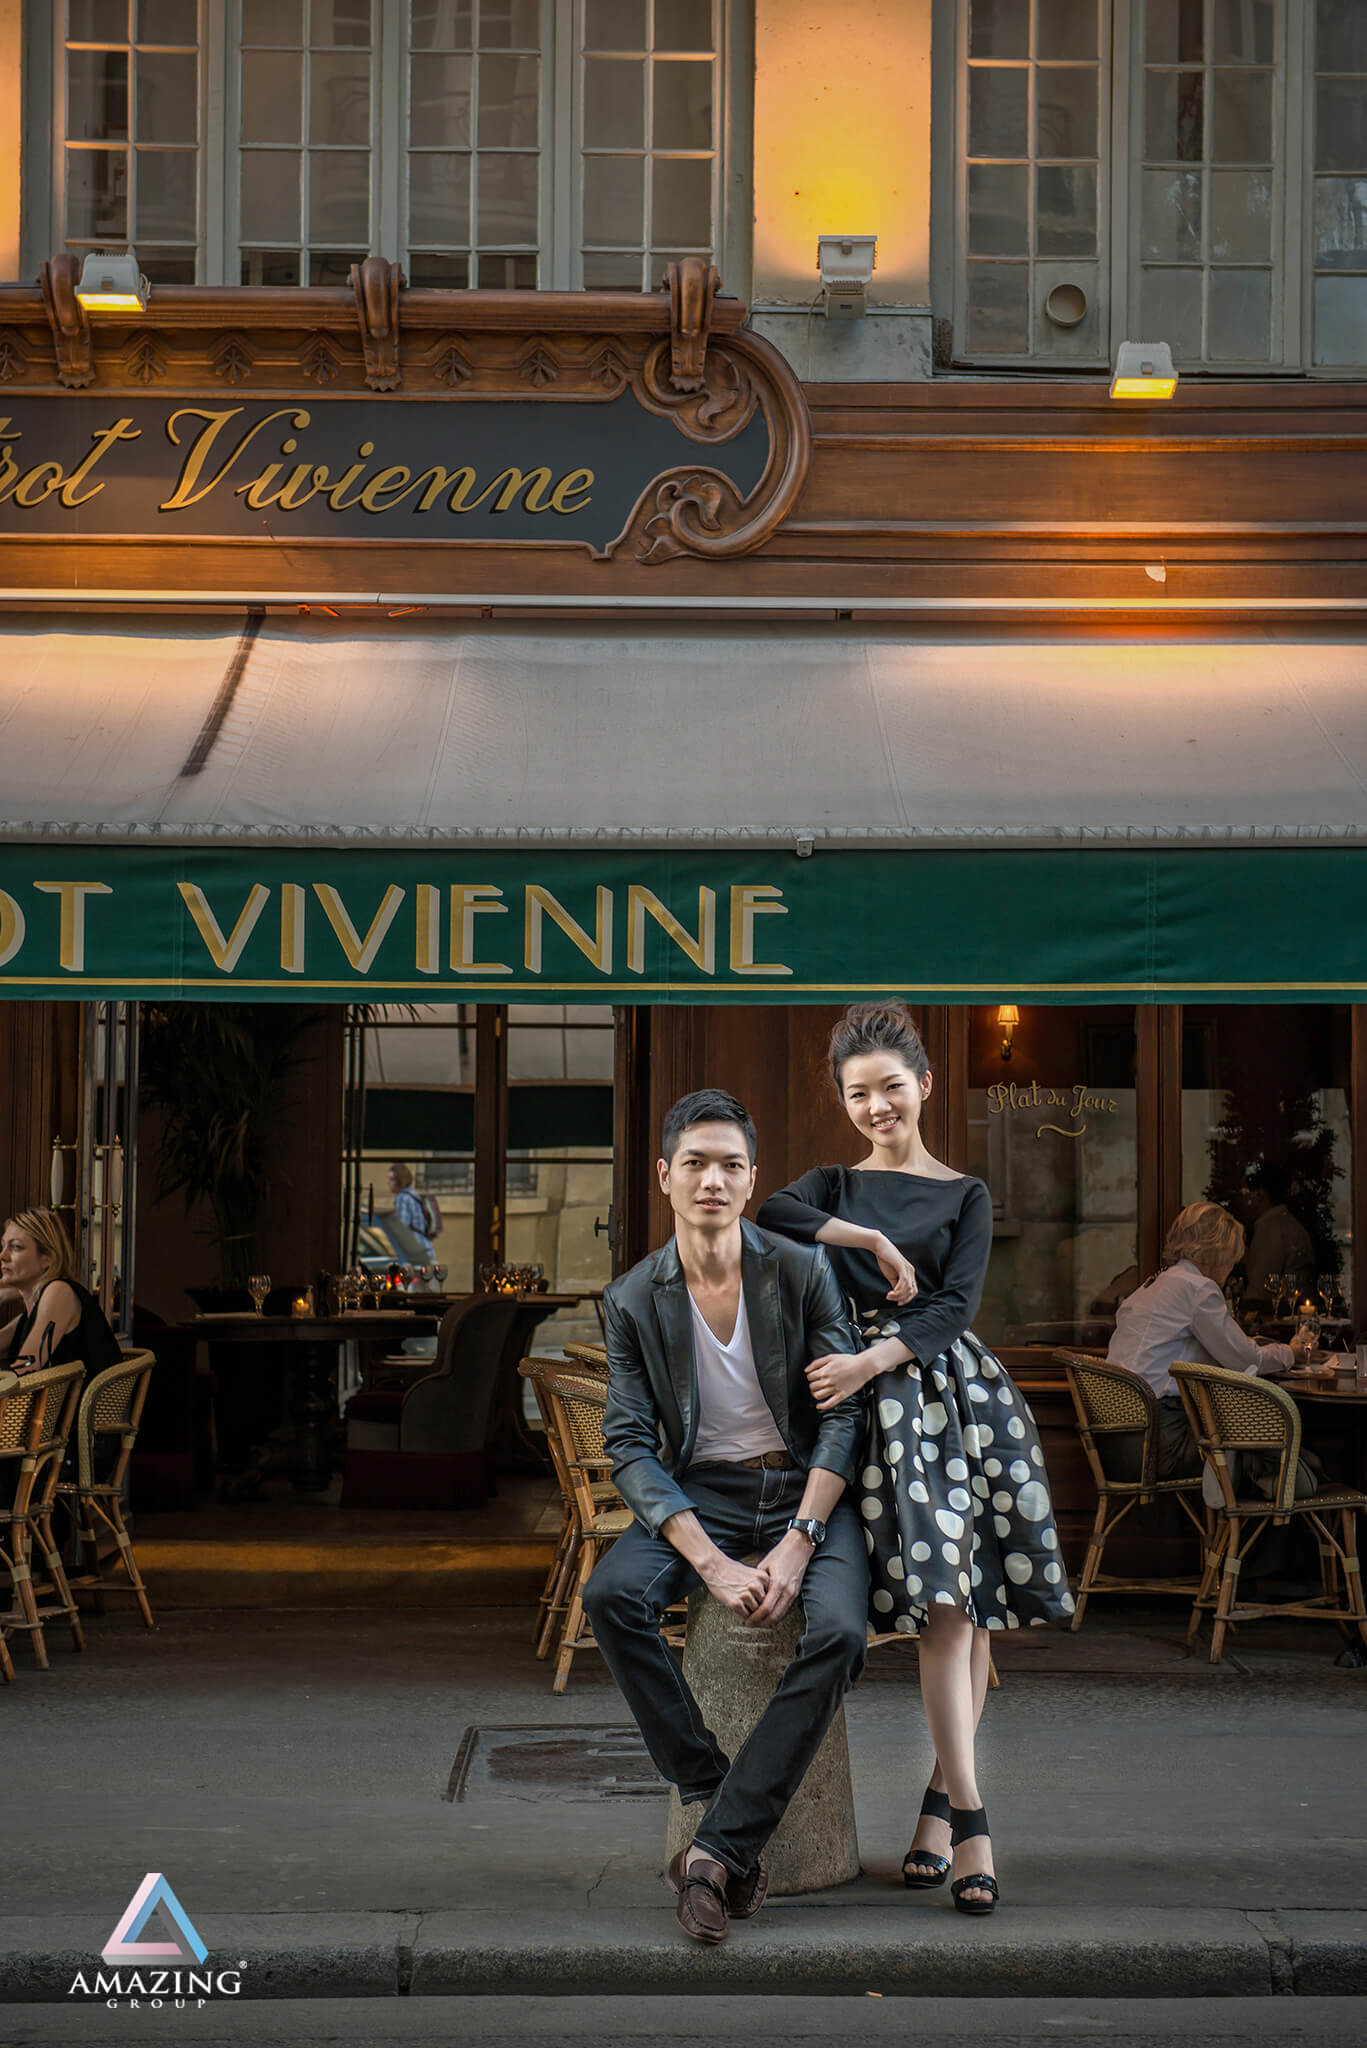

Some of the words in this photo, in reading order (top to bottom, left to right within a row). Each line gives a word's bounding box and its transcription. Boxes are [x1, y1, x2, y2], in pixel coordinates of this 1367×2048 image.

[158, 406, 596, 514] Vivienne
[176, 882, 793, 976] VIVIENNE
[986, 1080, 1042, 1113] Plat
[1047, 1089, 1065, 1106] du
[1069, 1084, 1119, 1118] Jour
